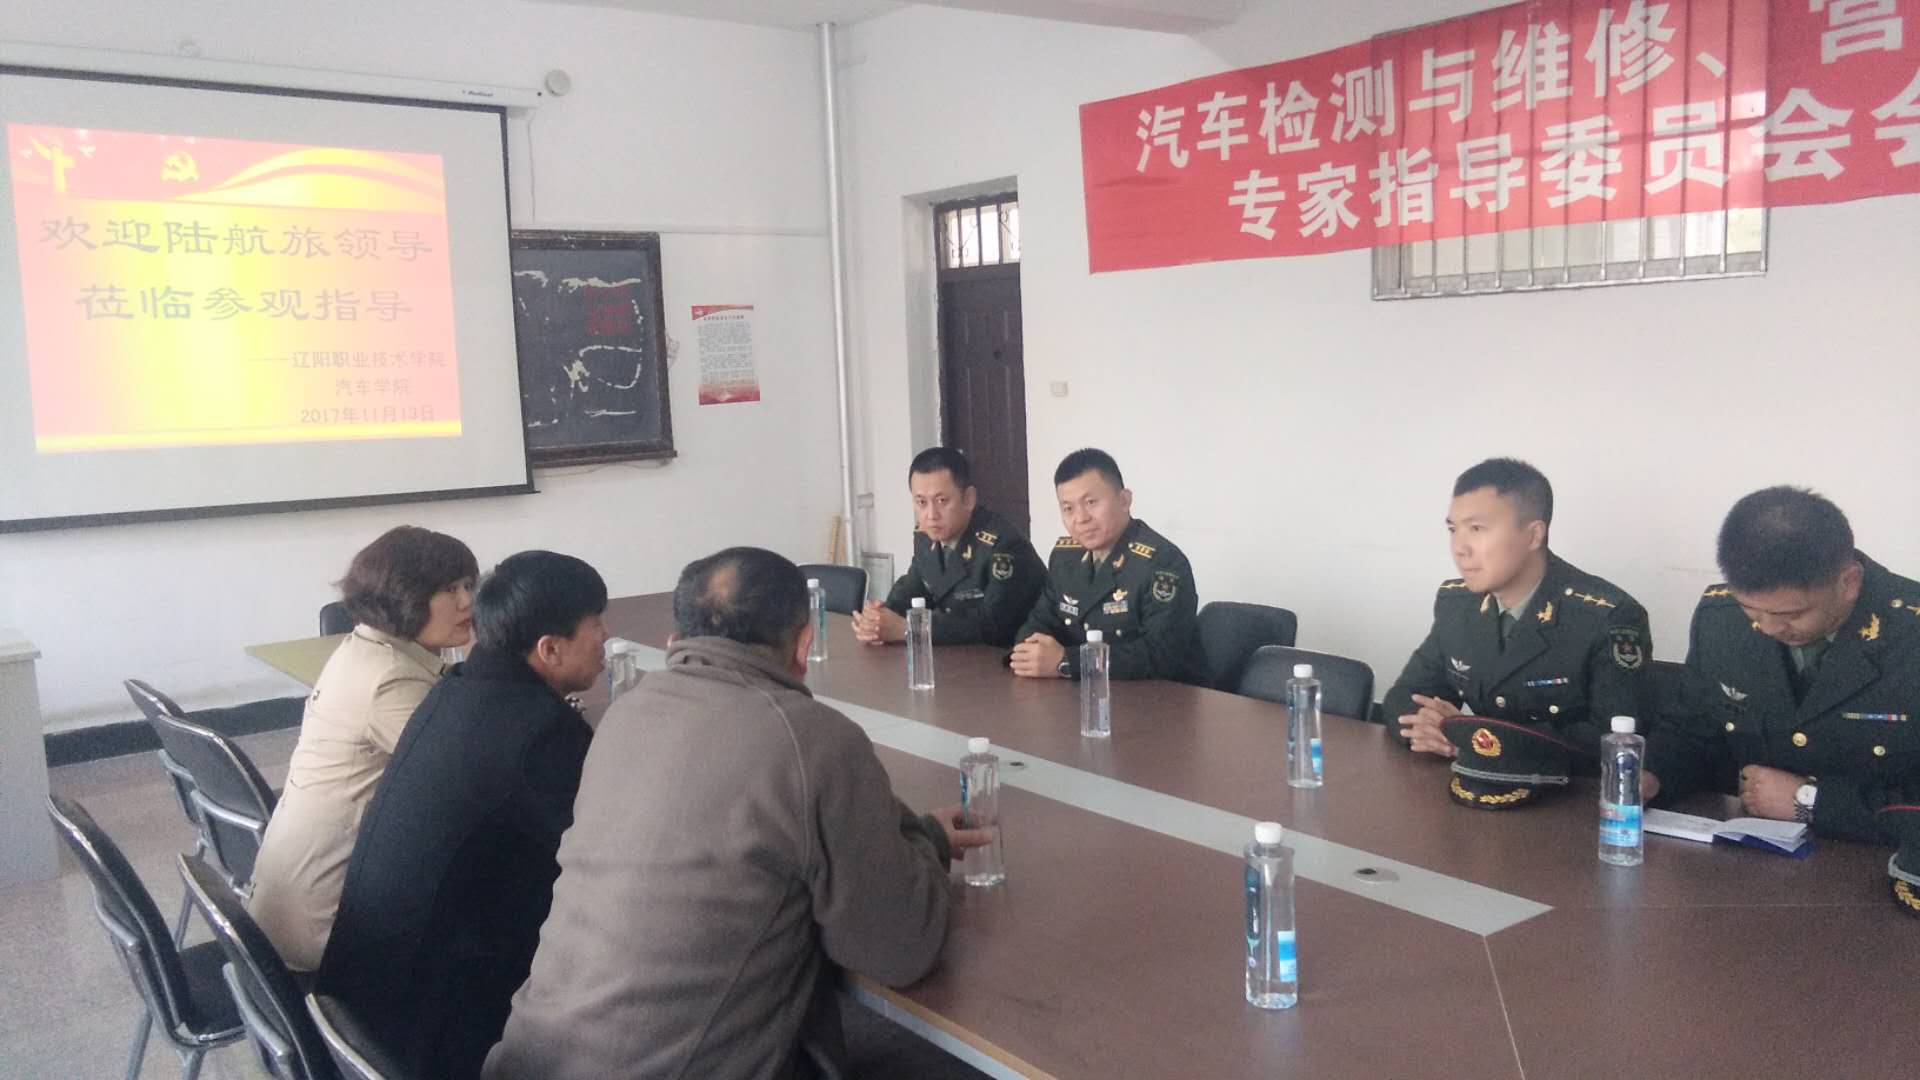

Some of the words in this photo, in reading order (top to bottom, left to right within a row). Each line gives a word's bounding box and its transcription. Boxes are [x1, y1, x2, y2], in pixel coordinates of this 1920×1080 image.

[39, 216, 433, 262] 欢迎陆航旅领导
[75, 284, 413, 322] 莅临参观指导
[335, 378, 414, 396] 汽车学院
[301, 405, 434, 424] 2017年11月13日
